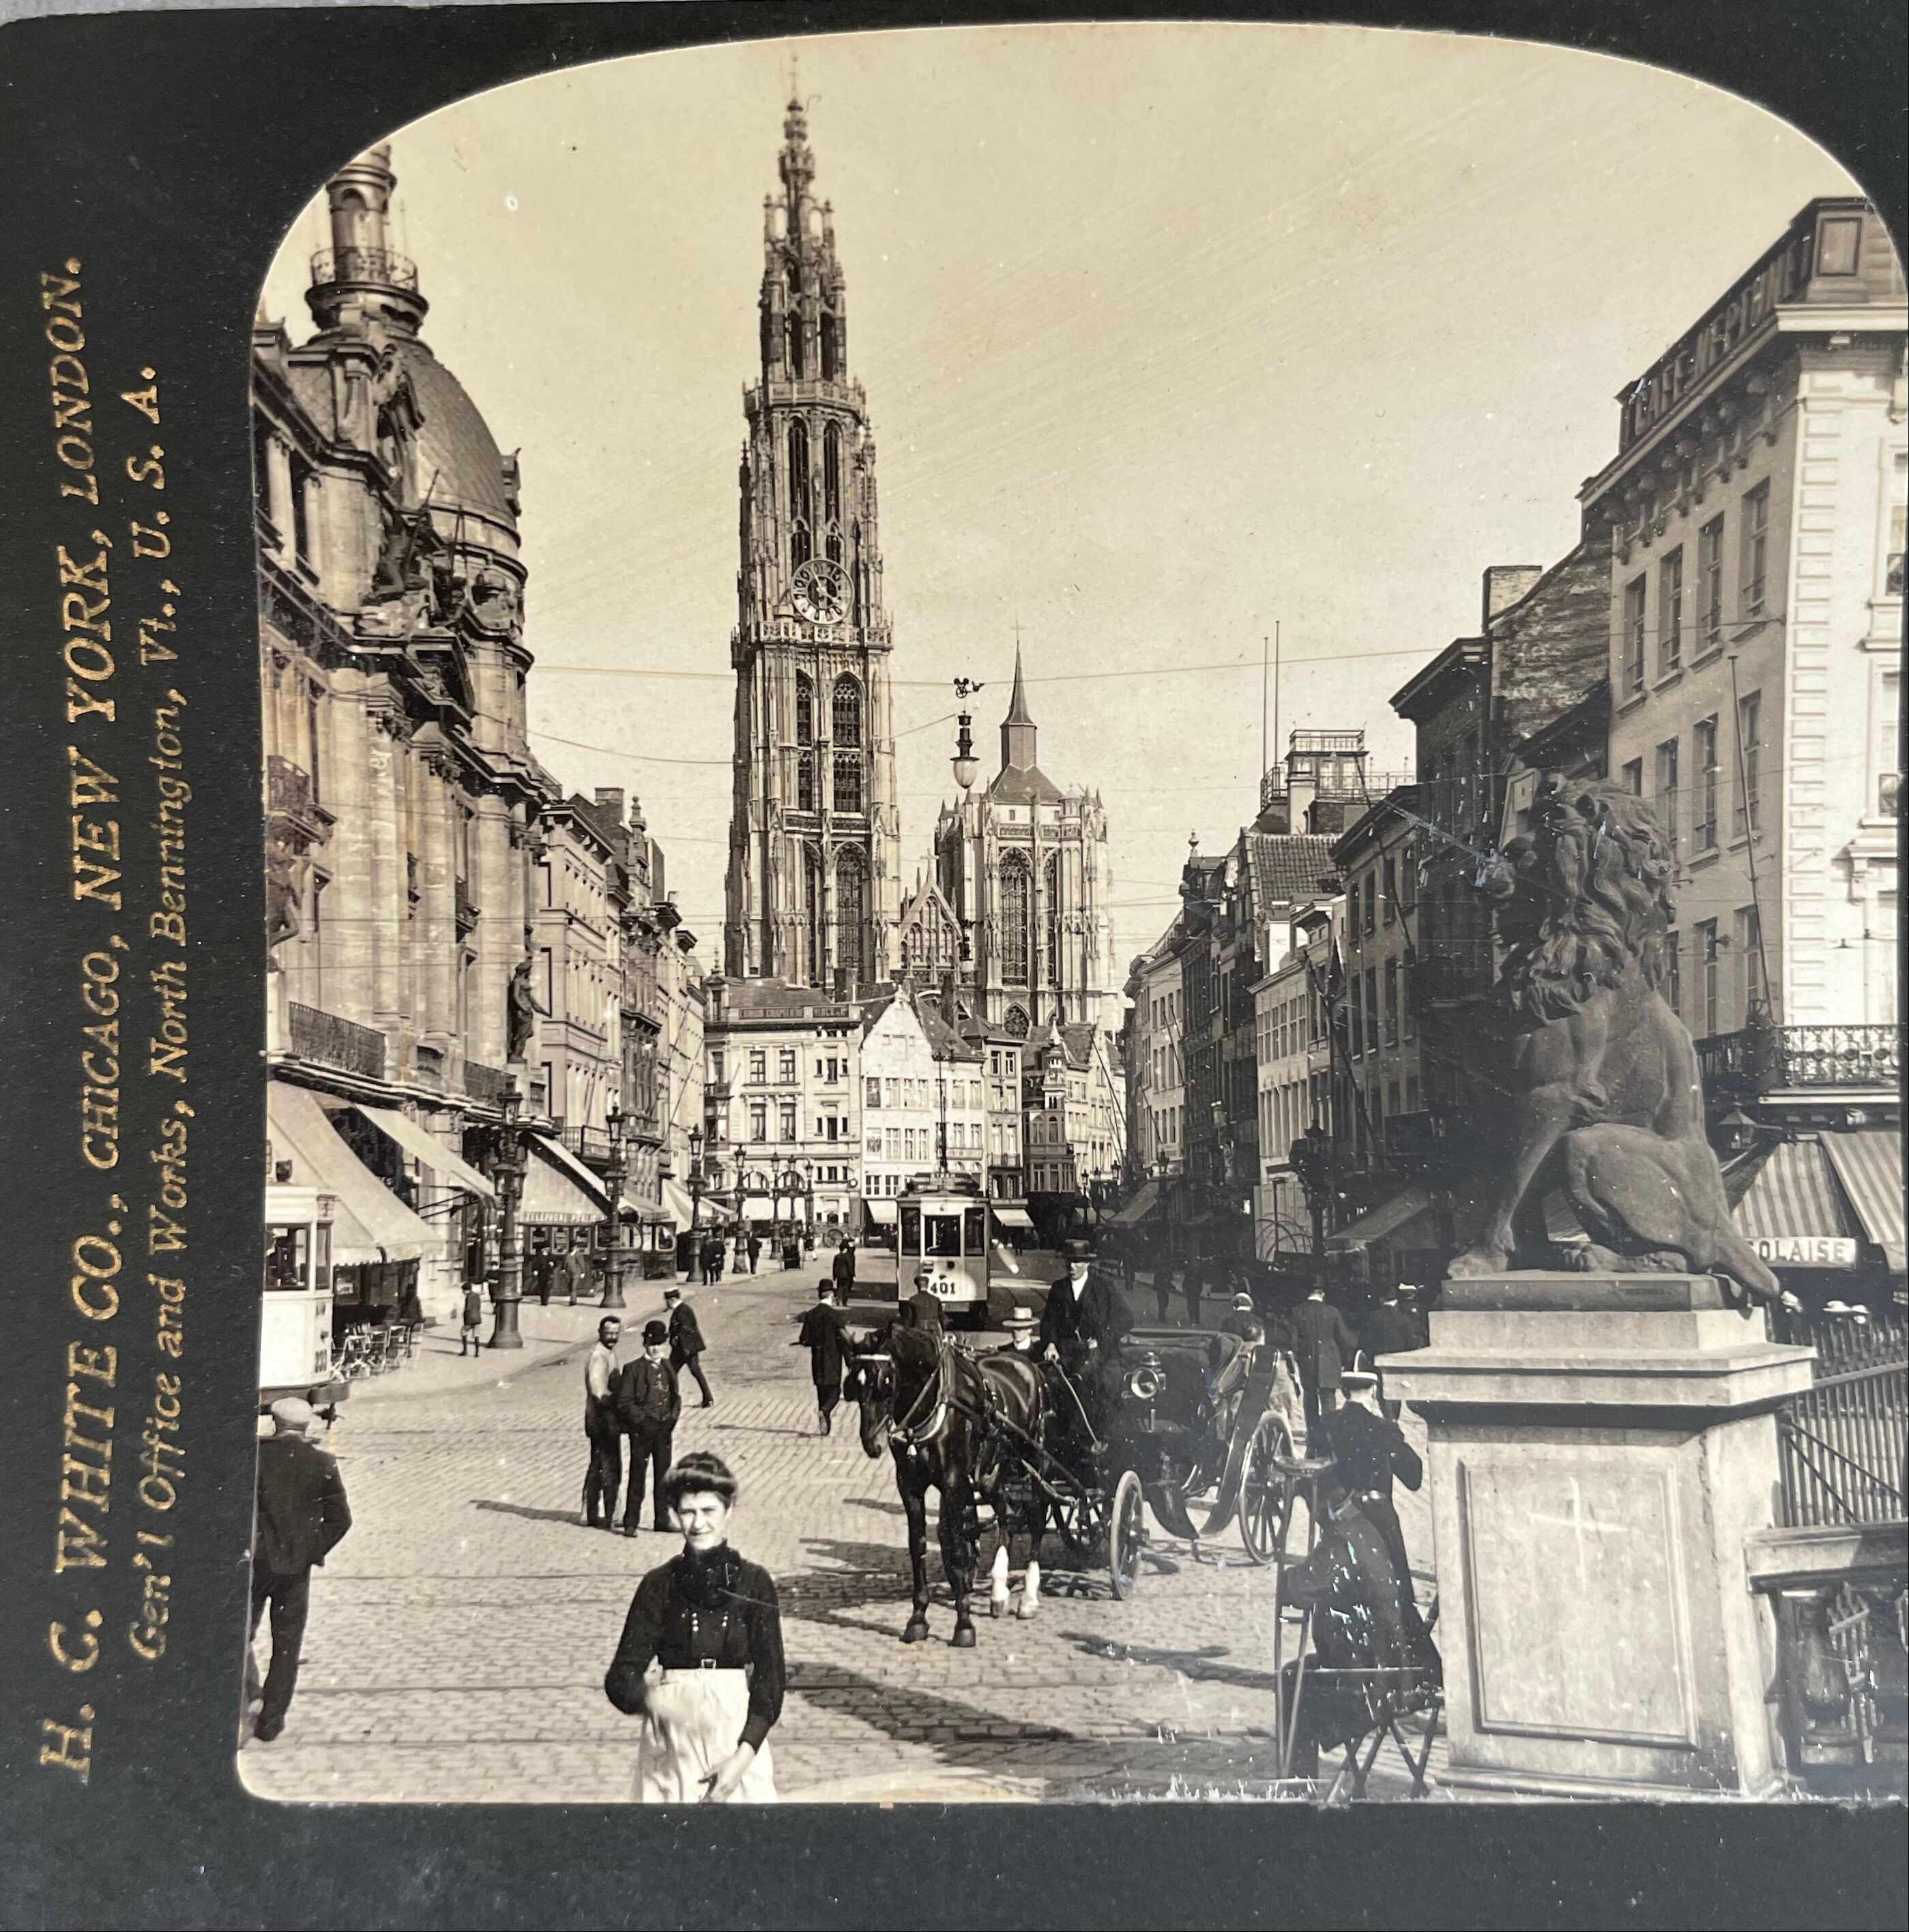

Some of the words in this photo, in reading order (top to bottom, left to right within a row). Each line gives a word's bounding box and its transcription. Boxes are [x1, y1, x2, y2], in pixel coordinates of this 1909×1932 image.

[40, 257, 99, 506] LONDON.
[120, 366, 160, 424] A.
[126, 445, 164, 490] S.
[130, 511, 171, 558] U.
[56, 529, 116, 723] YORK,
[138, 579, 181, 666] Vt.,
[66, 745, 122, 911] NEW
[148, 688, 192, 947] Bennington,
[80, 935, 130, 1170] CHICAGO,
[147, 961, 188, 1083] North
[147, 1100, 196, 1255] Works,
[69, 1194, 128, 1321] CO.,
[146, 1273, 186, 1358] and
[930, 1282, 956, 1294] 401
[55, 1341, 117, 1574] WHITE
[138, 1373, 186, 1511] Office
[48, 1609, 104, 1673] C.
[129, 1531, 171, 1660] Gen'l
[38, 1704, 95, 1781] H.
